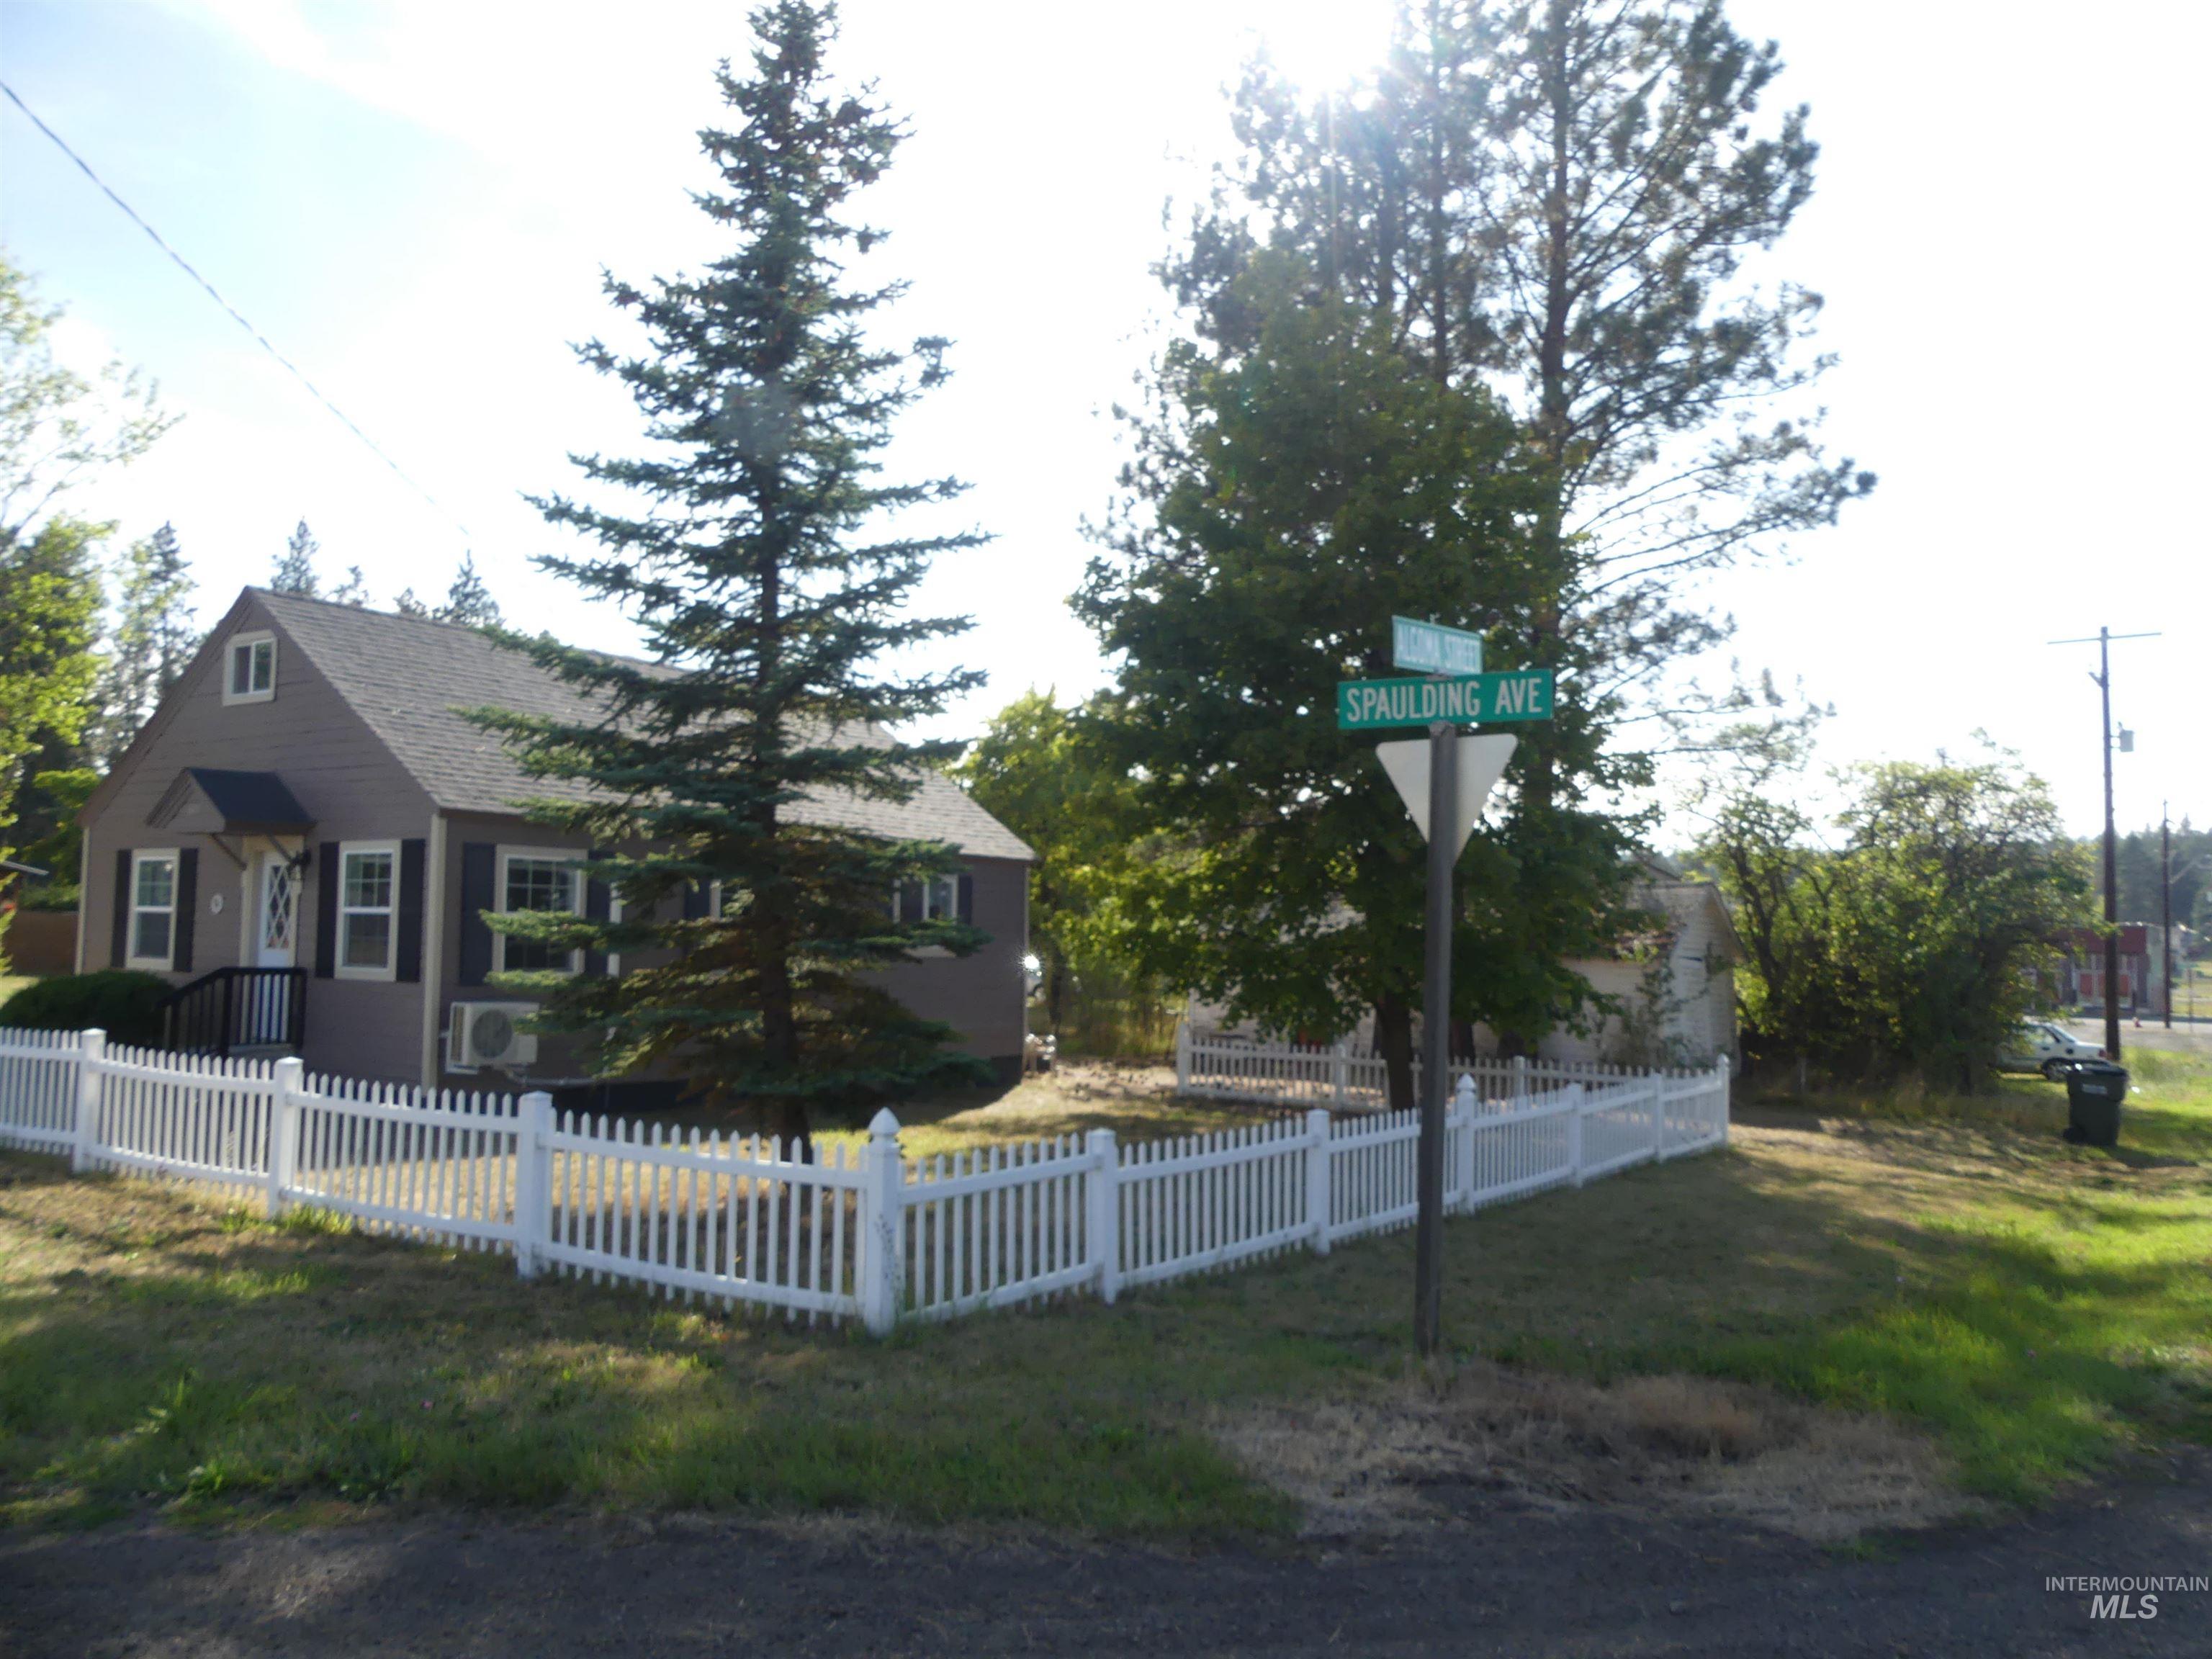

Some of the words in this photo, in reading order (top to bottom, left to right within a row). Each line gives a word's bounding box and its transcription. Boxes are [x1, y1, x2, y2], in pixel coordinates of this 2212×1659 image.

[1444, 634, 1480, 673] STREET
[1347, 681, 1480, 722] SPAULDING
[1495, 678, 1542, 715] AVE
